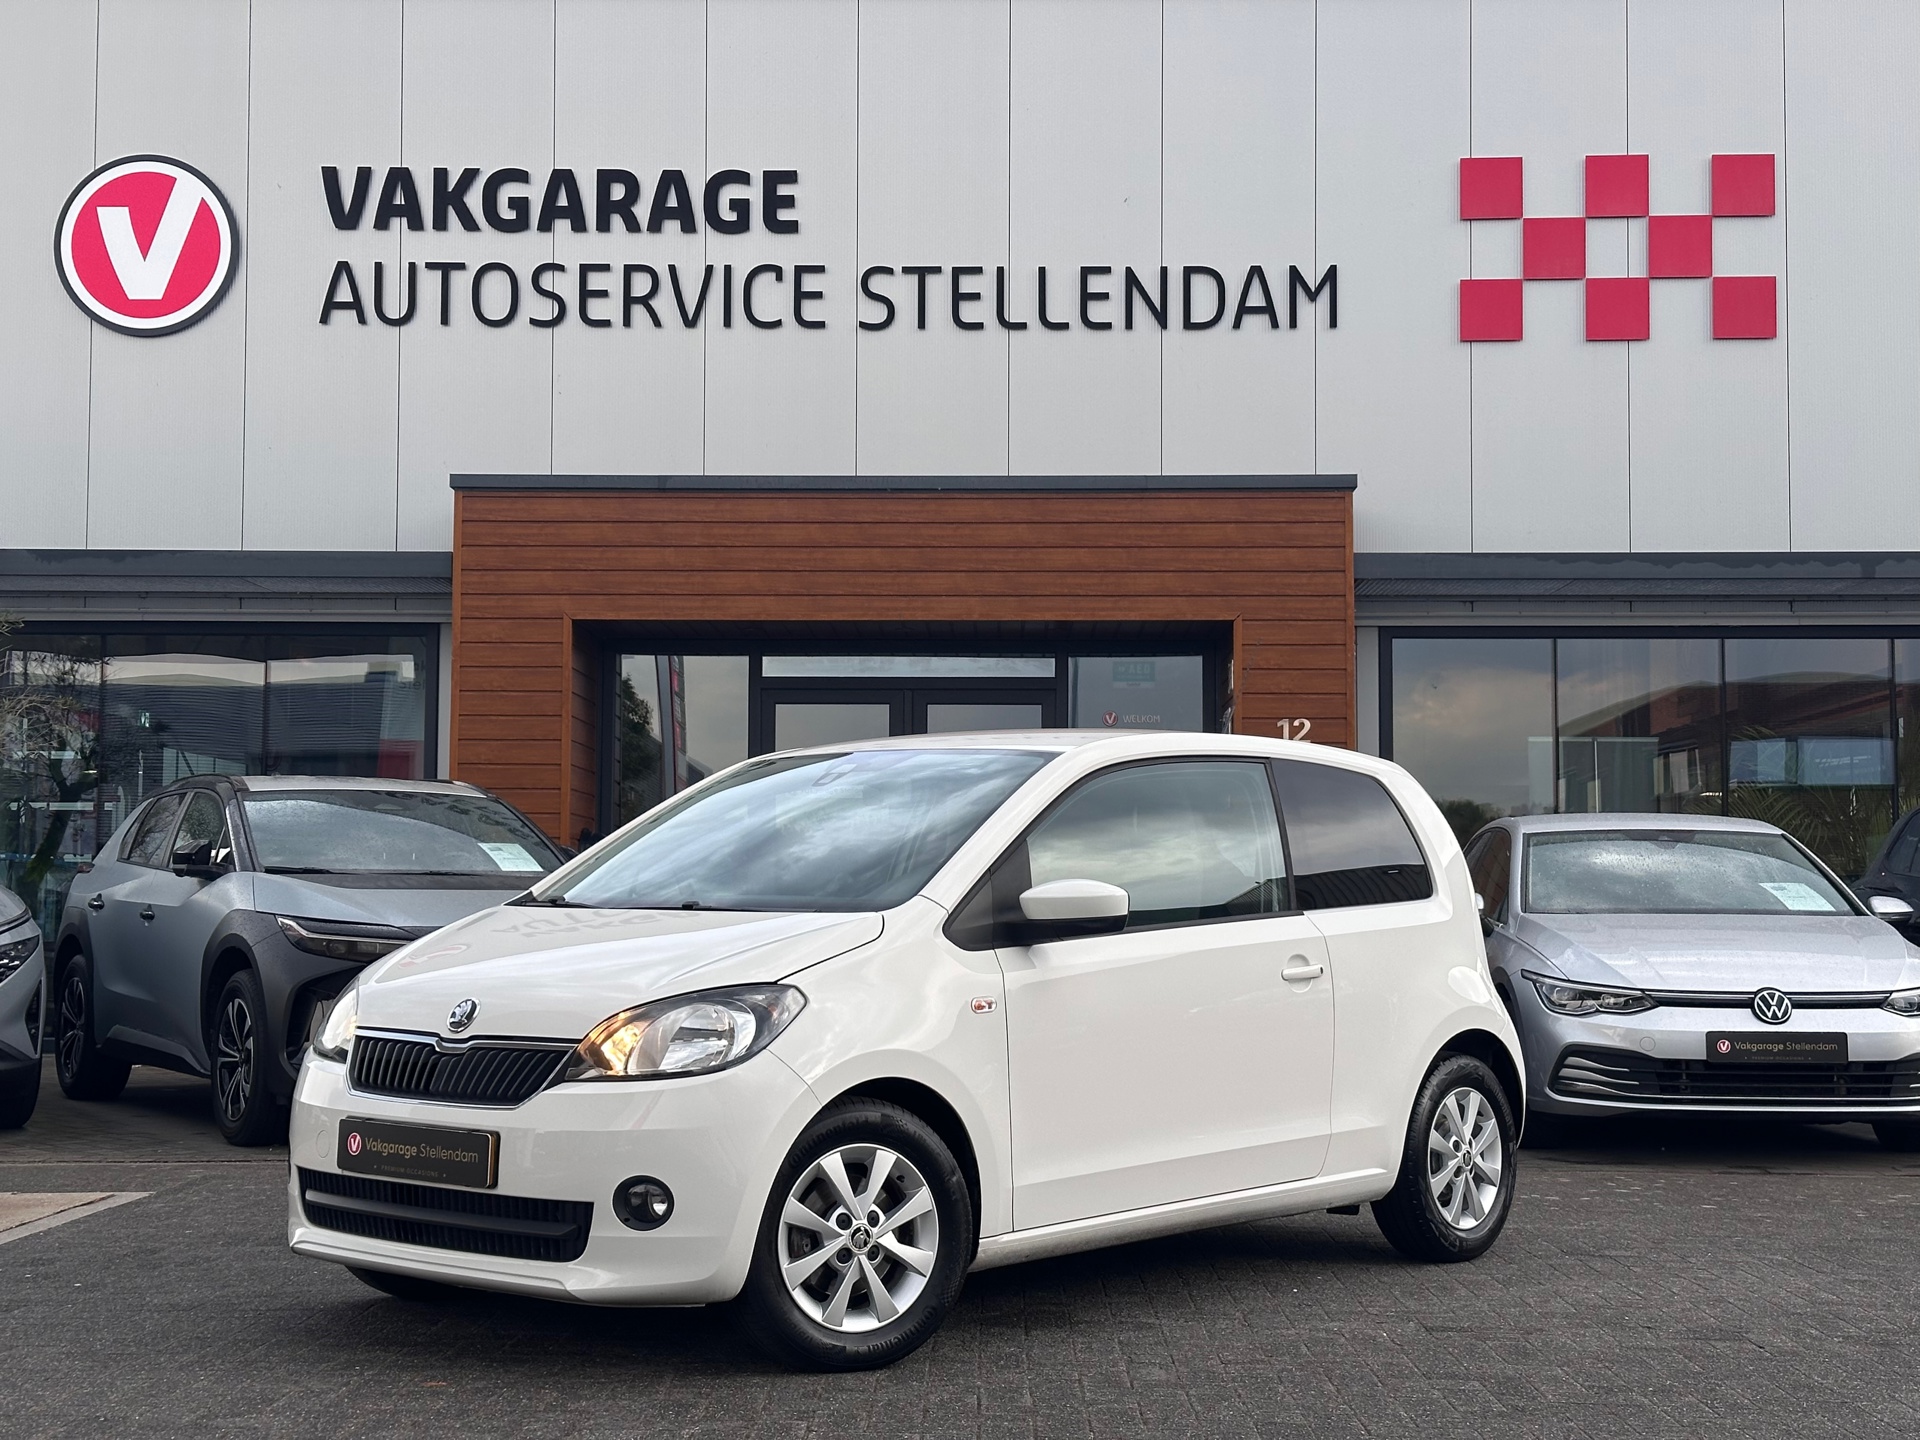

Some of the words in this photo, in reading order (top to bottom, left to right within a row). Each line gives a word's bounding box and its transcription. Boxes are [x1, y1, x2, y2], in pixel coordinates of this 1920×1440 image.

[320, 166, 799, 235] VAKGARAGE
[96, 172, 205, 301] V
[319, 260, 826, 329] AUTOSERVICE
[858, 264, 1338, 331] STELLENDAM
[1122, 714, 1161, 724] WELKOM
[1276, 718, 1312, 743] 12
[1734, 1041, 1784, 1053] Vakgarage
[1786, 1041, 1838, 1052] Stellendam
[365, 1137, 418, 1158] Vakgarage
[419, 1143, 479, 1163] Stellendam
